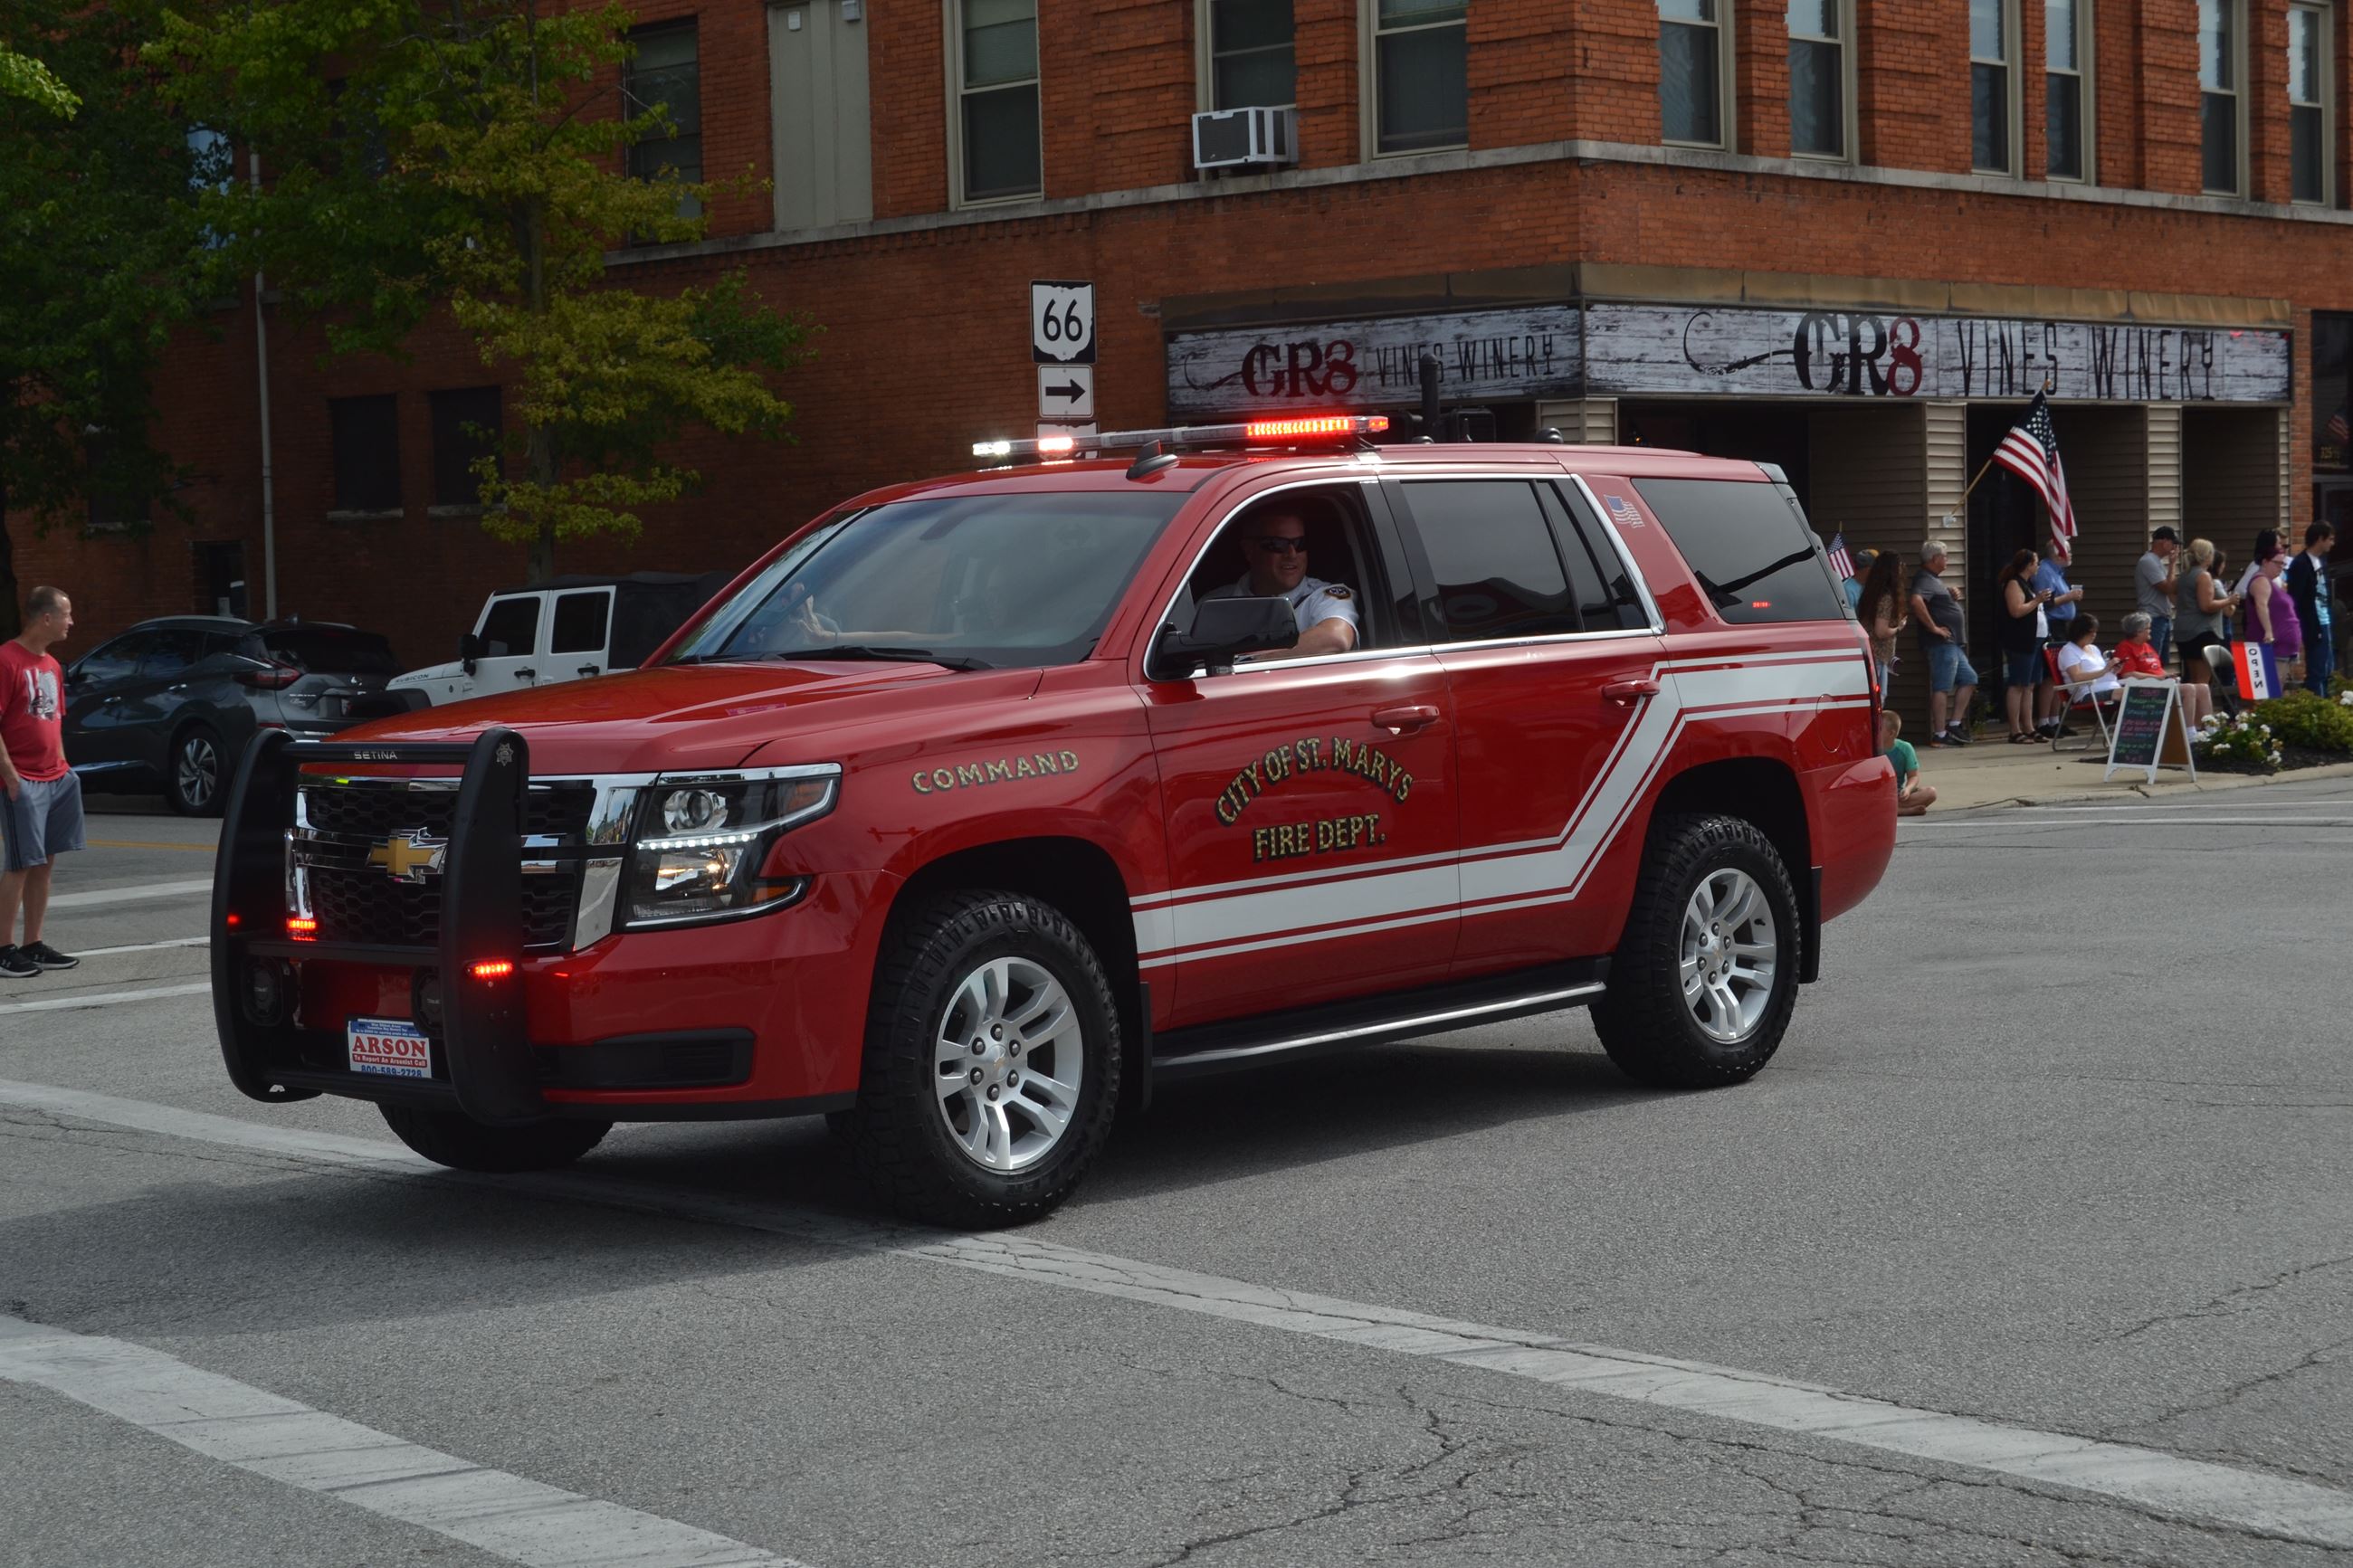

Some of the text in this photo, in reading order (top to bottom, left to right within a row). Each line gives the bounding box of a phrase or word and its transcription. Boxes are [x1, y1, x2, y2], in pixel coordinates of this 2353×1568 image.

[1043, 298, 1083, 342] 66
[1242, 339, 1358, 398] GR8
[1457, 334, 1554, 382] WINERY
[1793, 312, 2214, 400] GR8 VINES WINERY
[395, 673, 430, 683] RUBICON
[354, 750, 398, 760] SETINA
[912, 750, 1080, 794] COMMAND
[1215, 736, 1414, 824] CITY OF ST. MARYS
[1253, 813, 1386, 860] FIRE DEPT.
[352, 1035, 426, 1058] ARSON
[362, 1055, 380, 1064] Report
[390, 1058, 414, 1066] Arsonist
